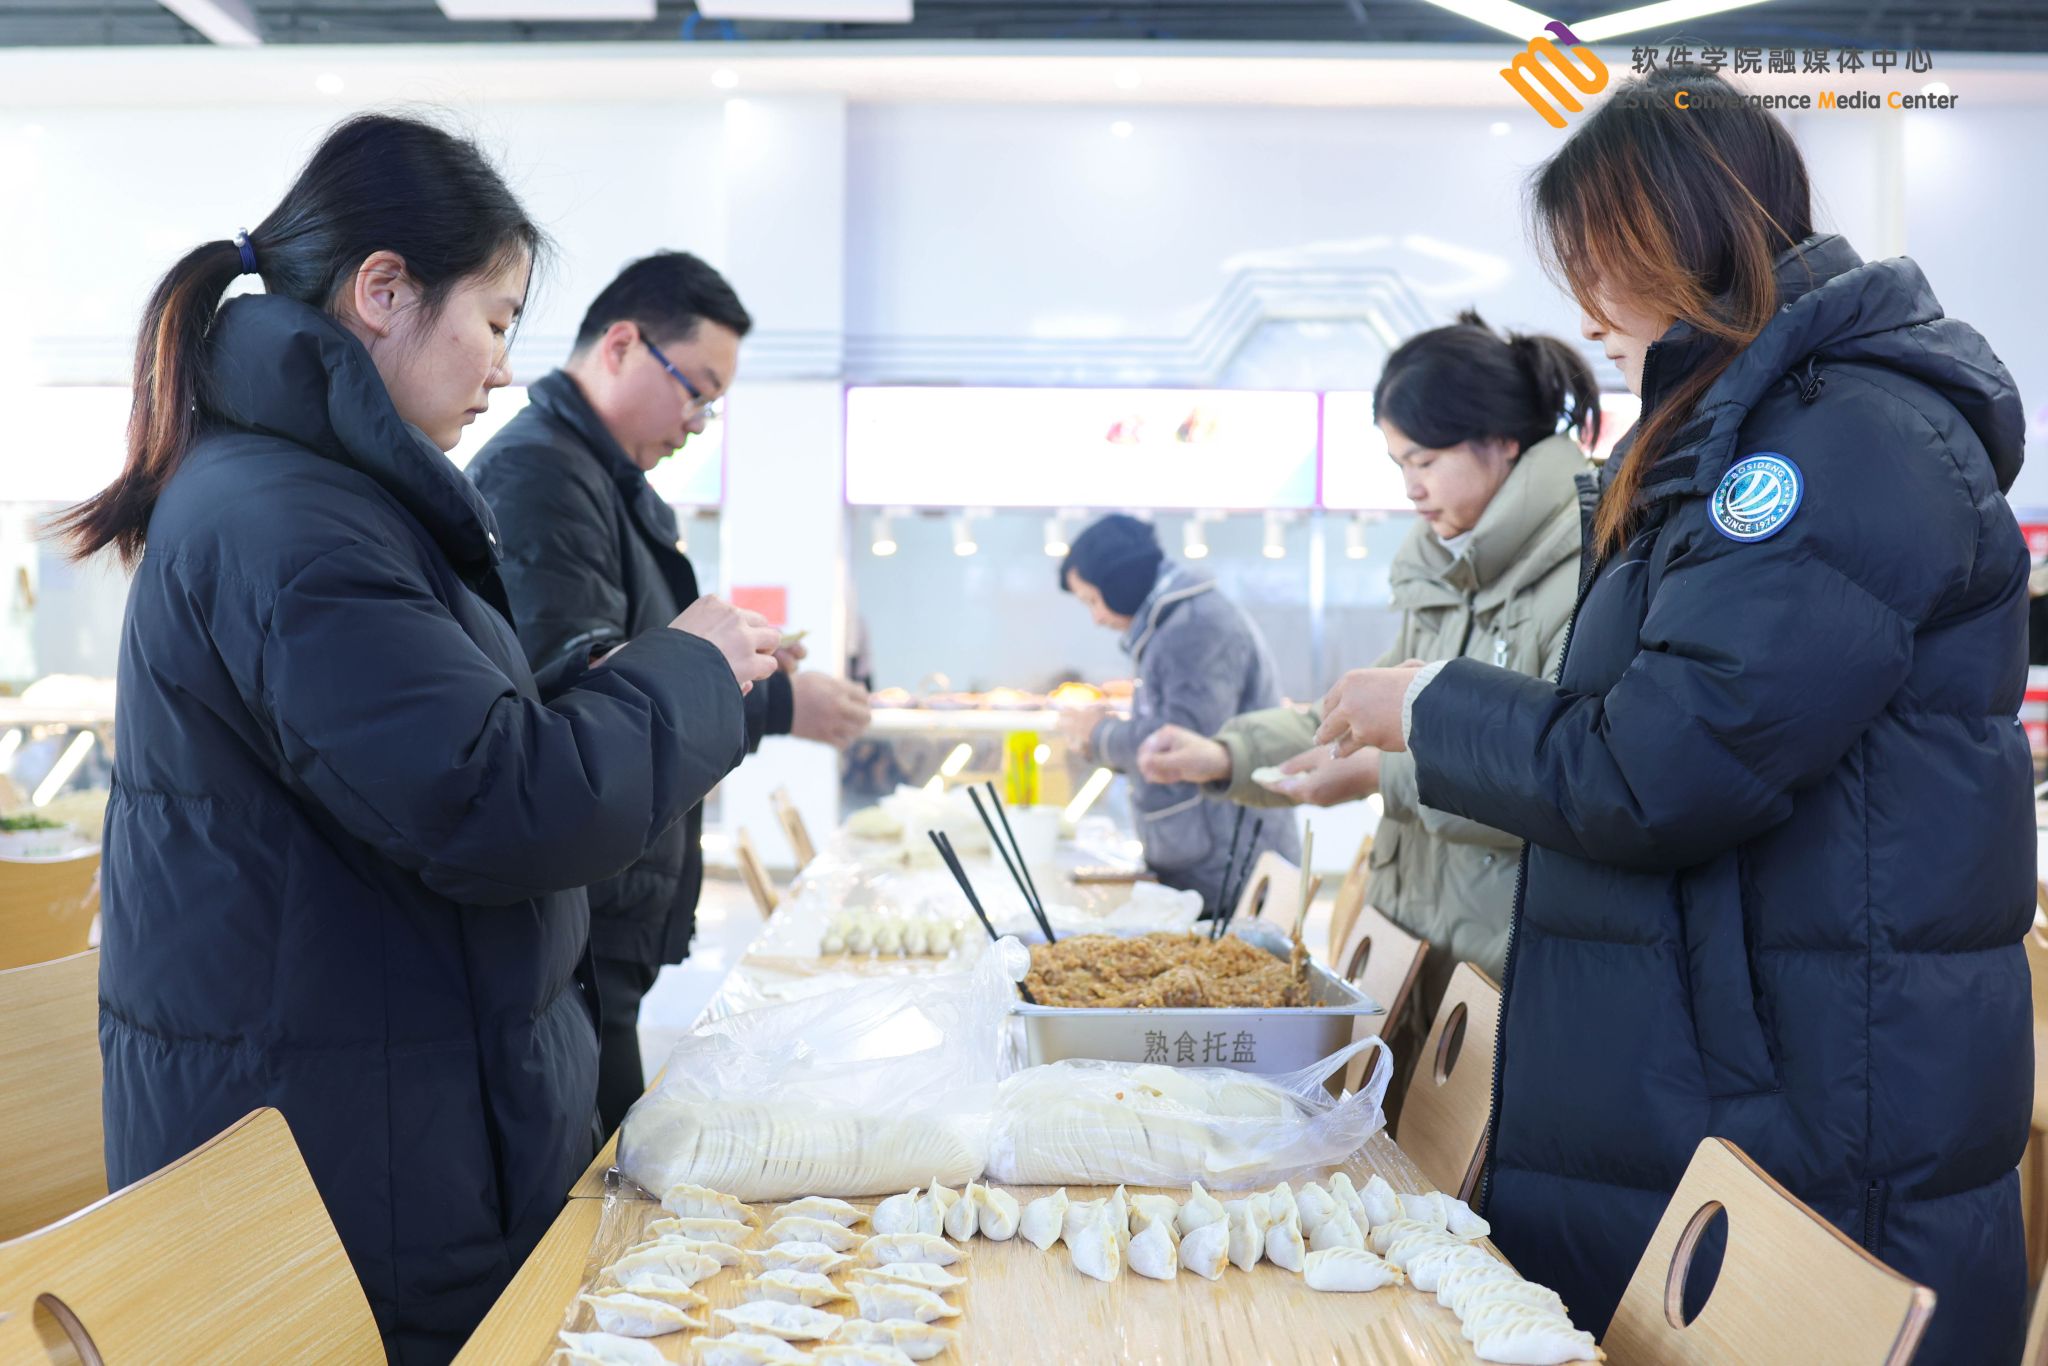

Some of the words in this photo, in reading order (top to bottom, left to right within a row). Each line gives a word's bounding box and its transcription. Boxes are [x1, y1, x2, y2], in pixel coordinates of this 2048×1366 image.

[1731, 462, 1785, 479] BOSIDENG
[1723, 516, 1752, 532] SINCE
[1755, 515, 1777, 531] 1976
[1143, 1029, 1257, 1063] 熟食托盘
